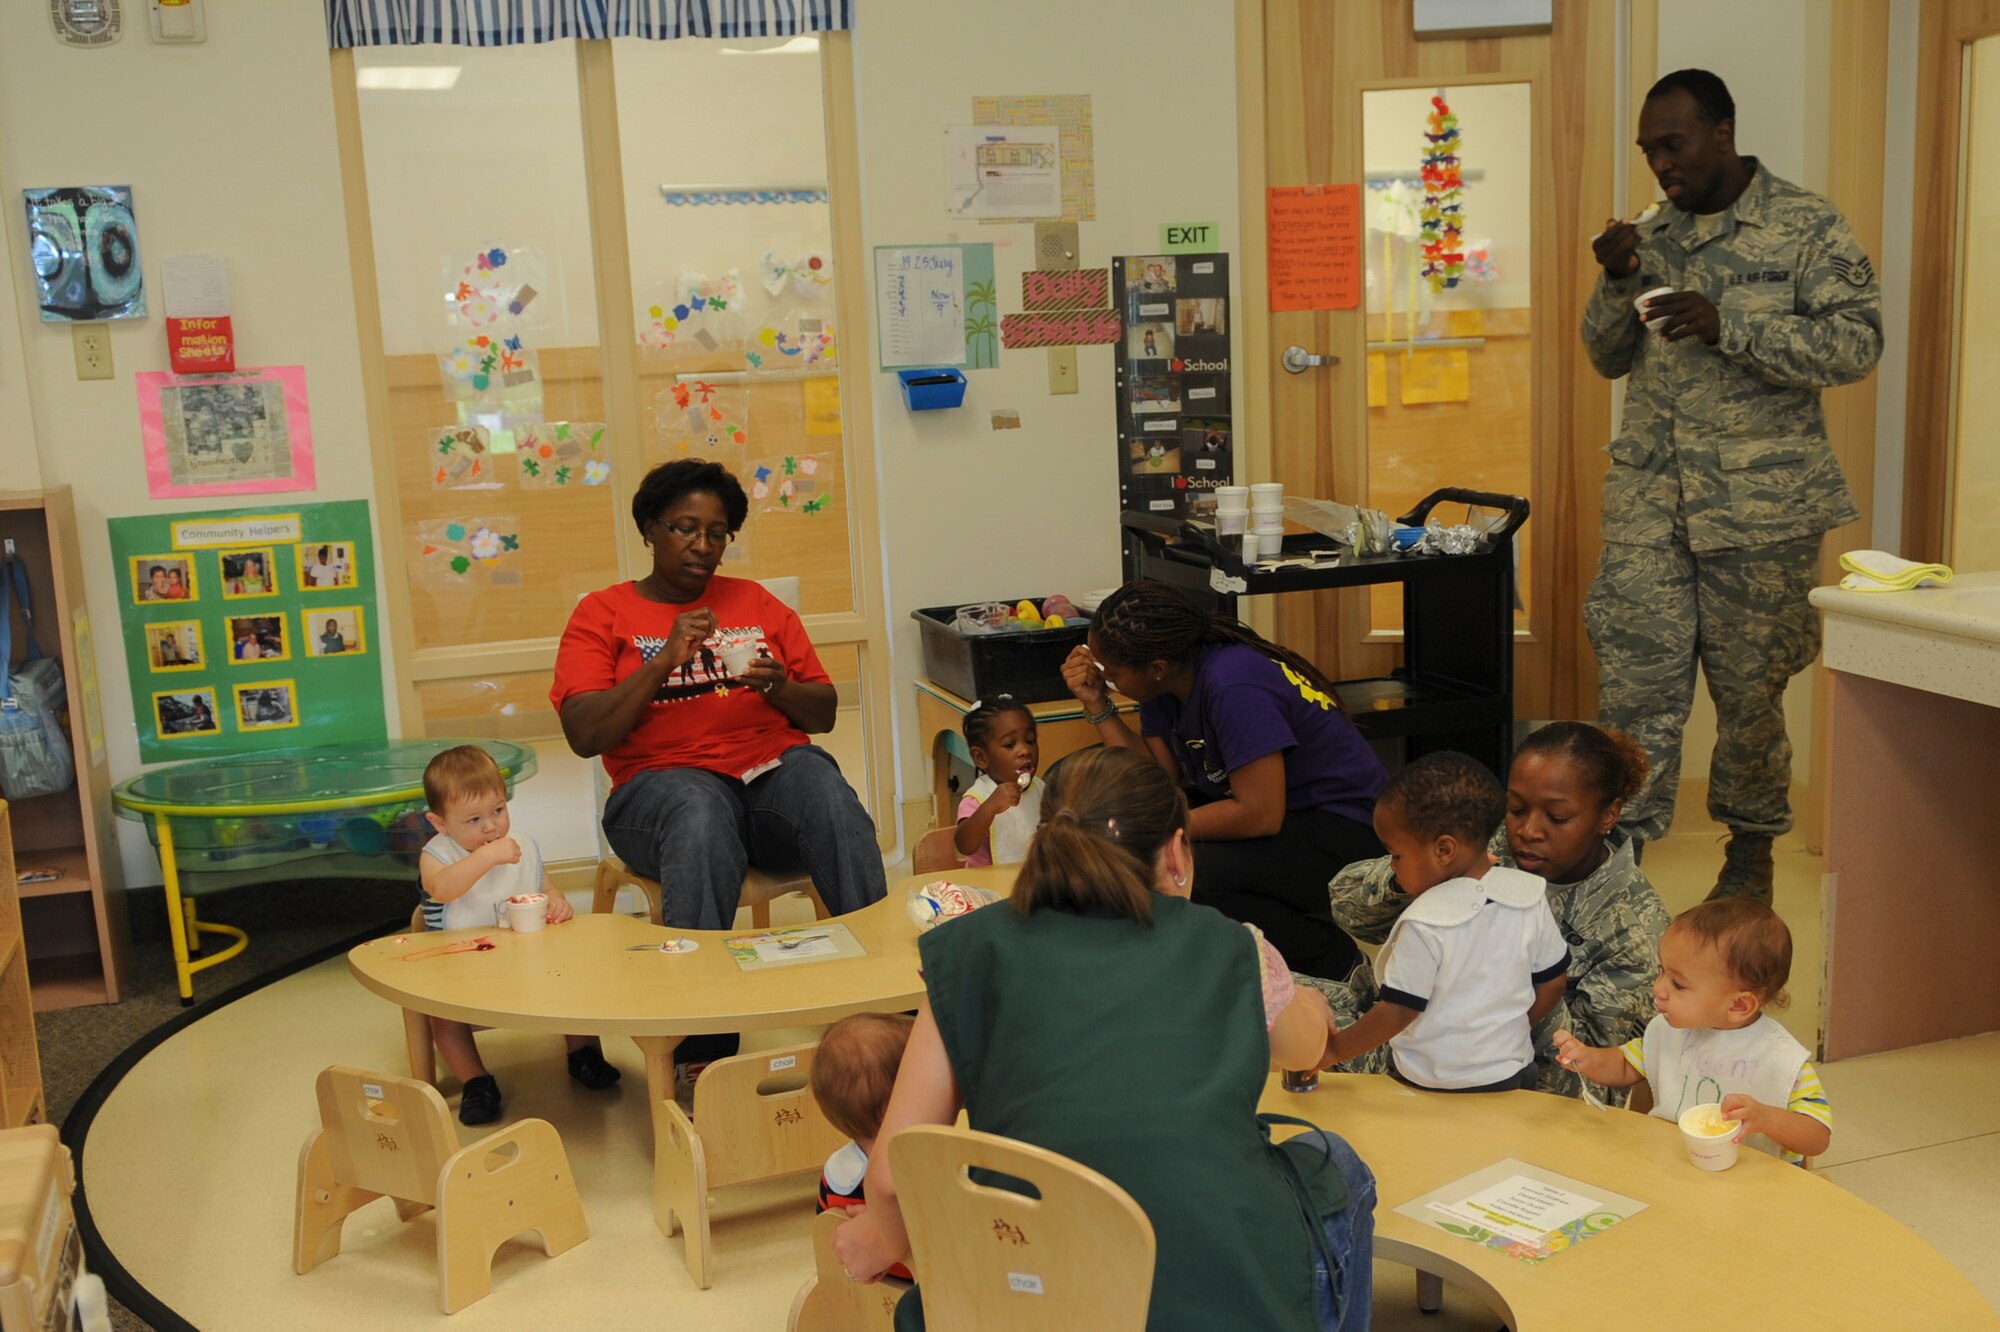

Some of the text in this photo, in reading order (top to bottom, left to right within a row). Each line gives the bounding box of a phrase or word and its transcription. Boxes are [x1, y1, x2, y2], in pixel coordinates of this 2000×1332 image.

[1167, 226, 1210, 244] EXIT
[929, 256, 954, 278] July
[1027, 271, 1103, 306] Daily
[179, 319, 217, 331] Infor
[1000, 312, 1122, 347] Schedule
[181, 333, 227, 346] mation
[178, 345, 226, 359] Sheets
[1184, 358, 1228, 371] School
[1187, 475, 1230, 489] School
[181, 524, 291, 540] Community Helpers
[774, 1058, 794, 1068] chair
[1010, 1276, 1037, 1289] chair
